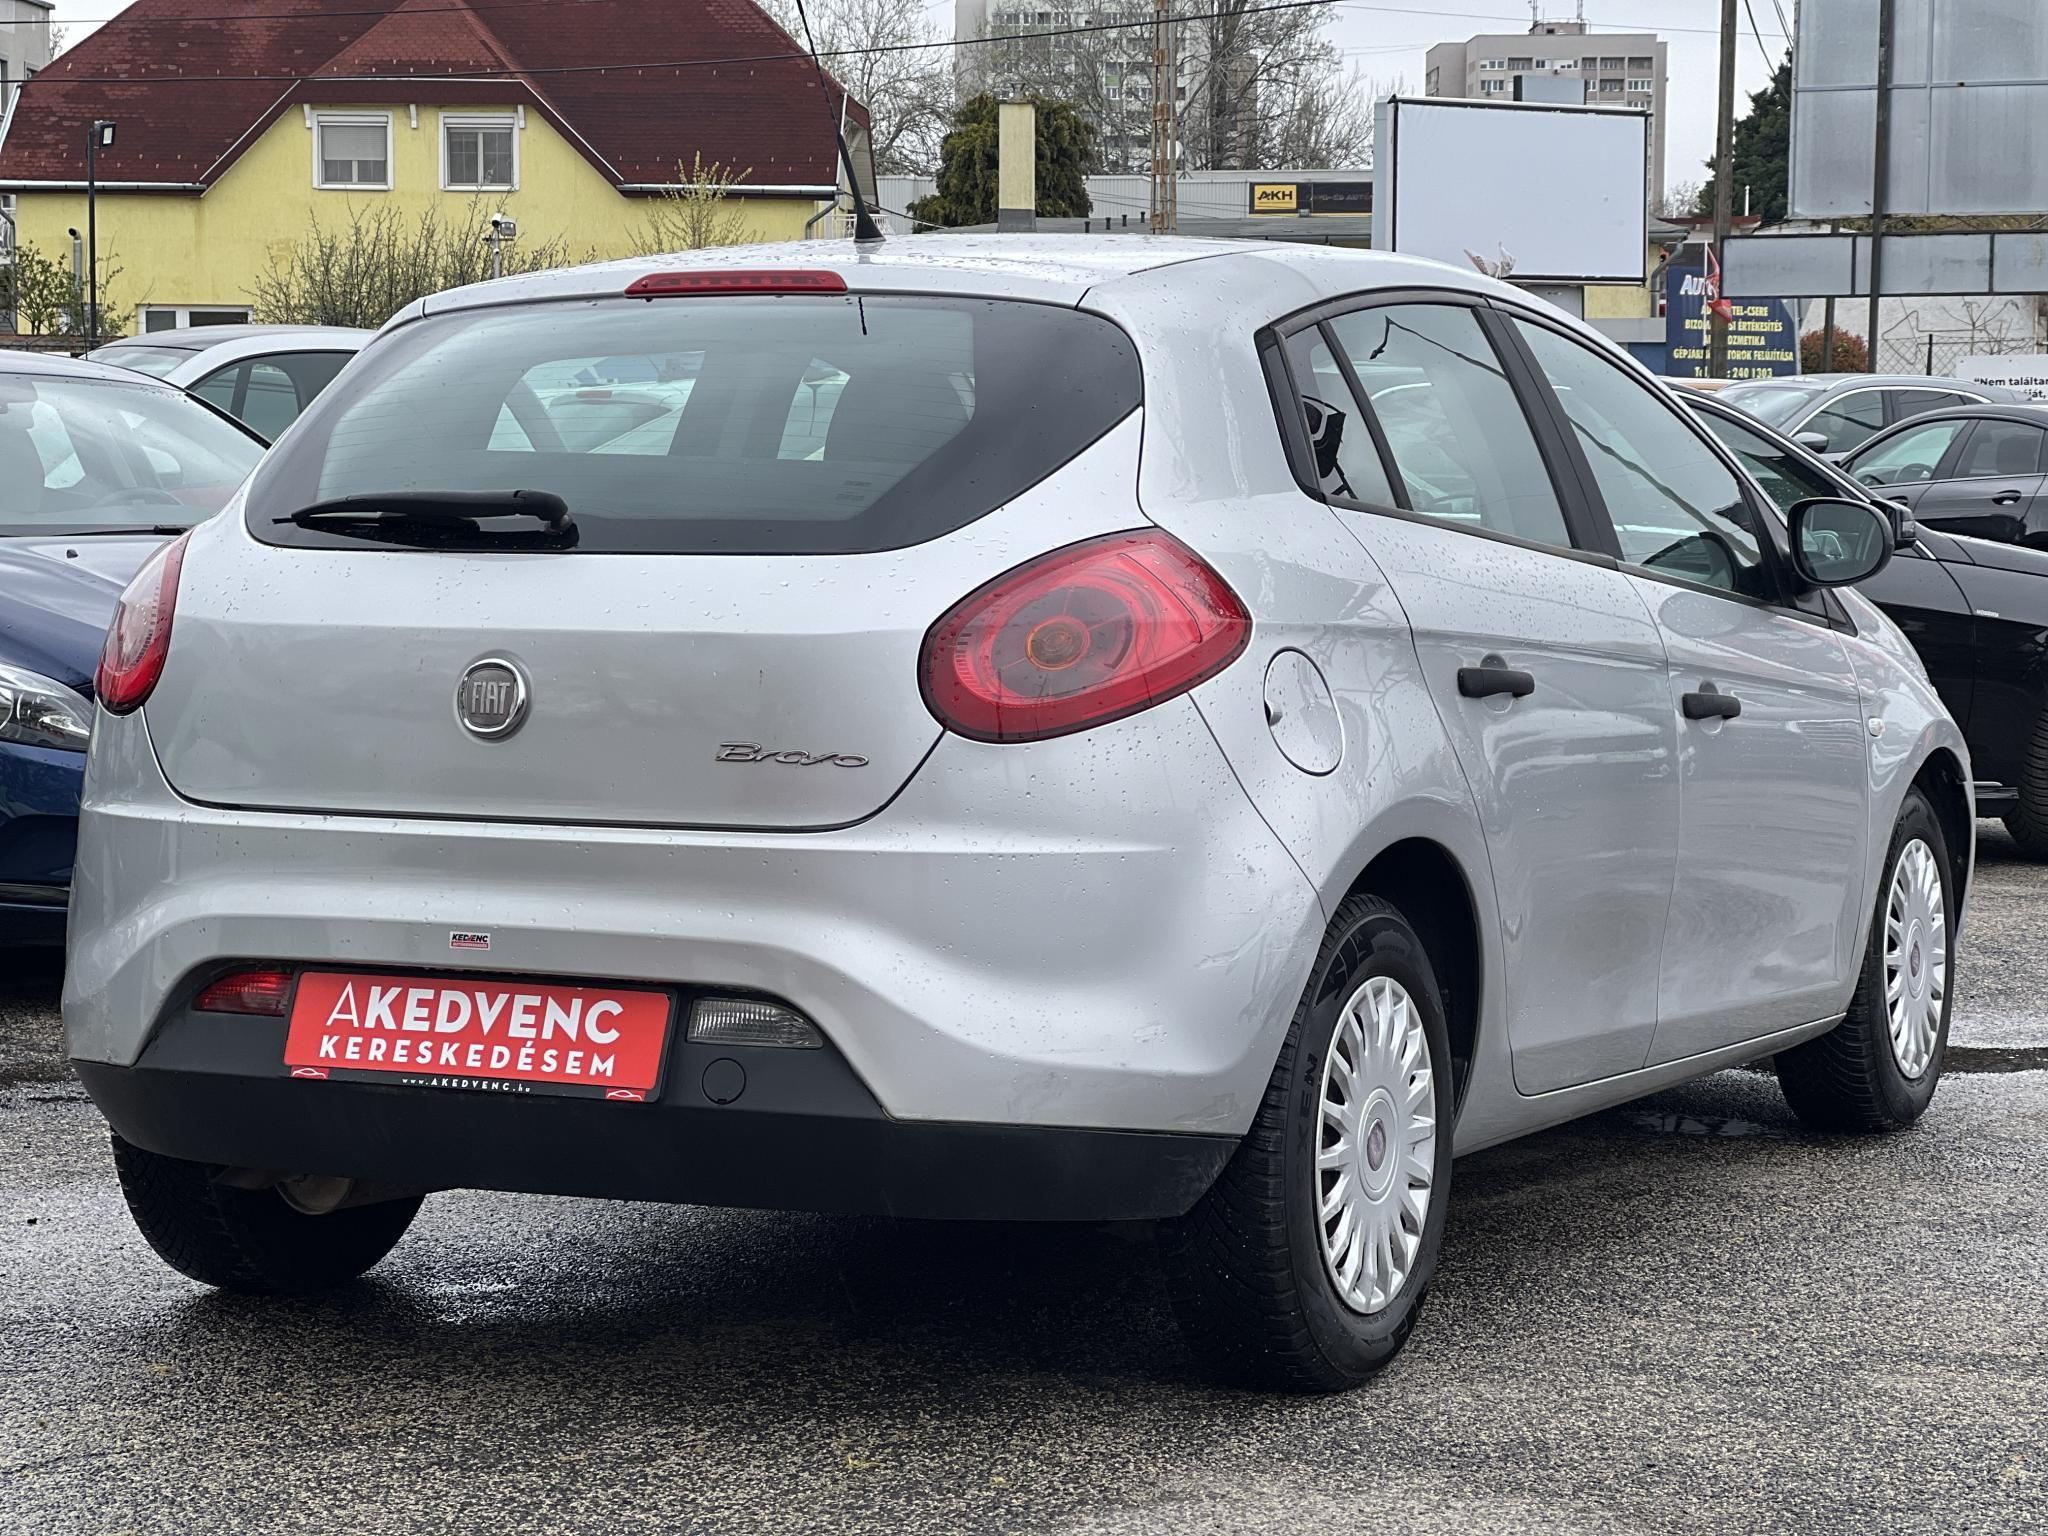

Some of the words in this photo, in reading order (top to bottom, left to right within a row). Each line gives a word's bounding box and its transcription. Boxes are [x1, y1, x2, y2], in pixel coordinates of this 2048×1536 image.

[1738, 319, 1783, 332] ÉRTÉKESÍTÉS
[1732, 367, 1749, 378] 240
[1751, 367, 1773, 378] 1303
[471, 681, 511, 714] FIAT
[714, 741, 870, 768] Bravo
[319, 1035, 616, 1078] KERESKEDÉSEM
[402, 1078, 531, 1092] www.AKEDVENC.hu
